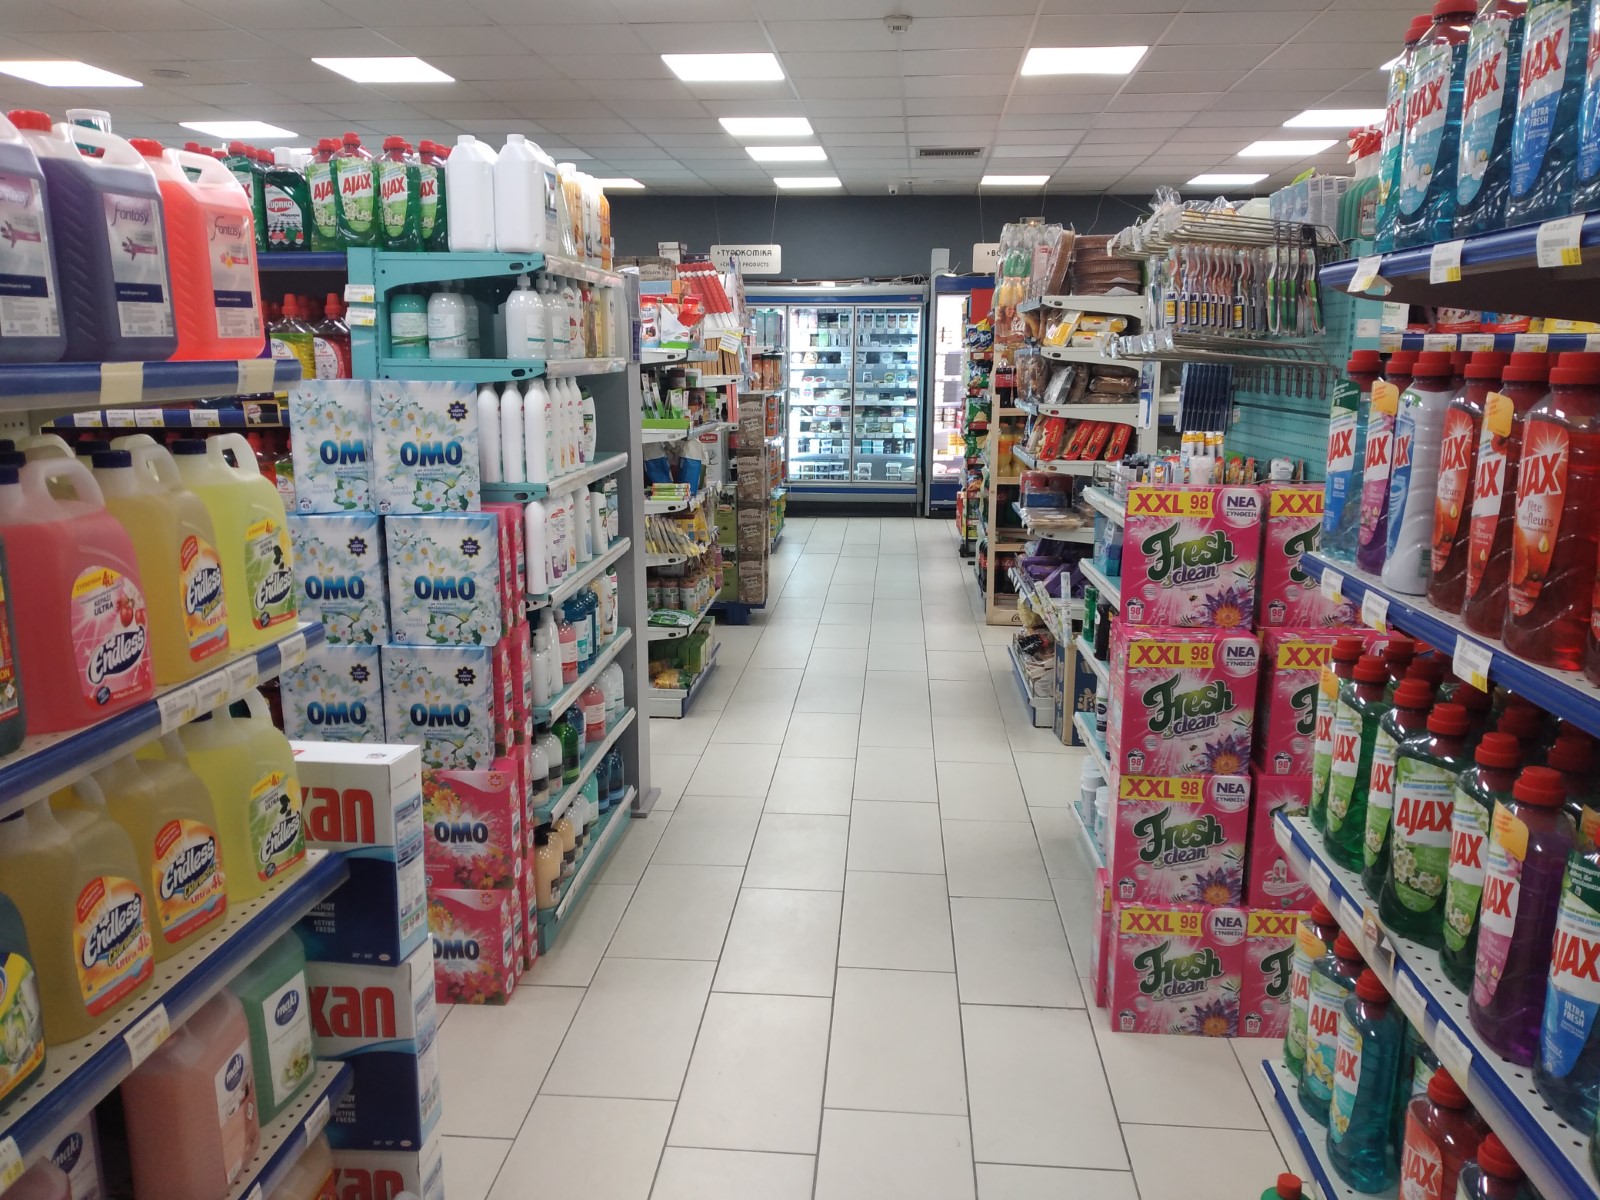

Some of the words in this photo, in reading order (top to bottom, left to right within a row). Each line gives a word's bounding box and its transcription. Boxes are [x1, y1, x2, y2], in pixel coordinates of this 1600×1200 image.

[1530, 116, 1548, 127] FRESH
[313, 181, 334, 201] AJA
[343, 173, 372, 196] AJAX
[382, 177, 405, 200] AJAX
[111, 204, 149, 226] Fantasy
[211, 216, 242, 241] Fantasy
[320, 440, 366, 466] OM
[400, 441, 463, 467] OMO
[1328, 429, 1353, 467] JAX
[1518, 452, 1561, 508] JAX
[1134, 493, 1183, 513] XXL
[1190, 495, 1209, 509] 98
[1227, 496, 1256, 508] ΝΕΑ
[1142, 521, 1238, 581] Fresh
[1172, 565, 1216, 585] clean
[187, 565, 221, 614] Endless
[256, 570, 292, 611] Endless
[305, 575, 365, 600] OMO
[414, 576, 476, 601] OMO
[94, 602, 114, 616] ULTRA
[1130, 606, 1141, 615] 98
[1272, 608, 1283, 617] 98
[88, 629, 145, 685] Endless
[1135, 645, 1185, 665] XXL
[1191, 646, 1209, 660] 98
[1227, 646, 1255, 658] ΝΕΑ
[1142, 672, 1237, 731] Fresh
[307, 702, 367, 726] OMO
[410, 703, 471, 728] OMO
[1173, 715, 1217, 735] clean
[1131, 757, 1141, 766] 98
[1277, 761, 1289, 769] 98
[1125, 779, 1174, 798] XXL
[1181, 781, 1199, 795] 98
[1216, 783, 1245, 794] ΝΕΑ
[1396, 797, 1454, 836] AJAX
[261, 814, 301, 863] Endless
[434, 821, 488, 844] OMO
[1133, 806, 1228, 861] Fresh
[1164, 847, 1207, 865] clean
[160, 836, 216, 900] Endless
[1122, 885, 1133, 894] 98
[82, 892, 142, 969] Endless
[1126, 913, 1174, 932] XXL
[1180, 915, 1198, 929] 98
[1214, 916, 1243, 928] ΝΕΑ
[1134, 940, 1225, 995] Fresh
[1163, 979, 1206, 996] clean
[275, 996, 297, 1021] maki
[1564, 1009, 1584, 1028] FRESH
[1565, 1000, 1585, 1019] ULTRA
[1123, 1017, 1133, 1026] 98
[1248, 1020, 1259, 1029] 98
[1310, 1004, 1340, 1037] AJA
[226, 1058, 243, 1085] maki
